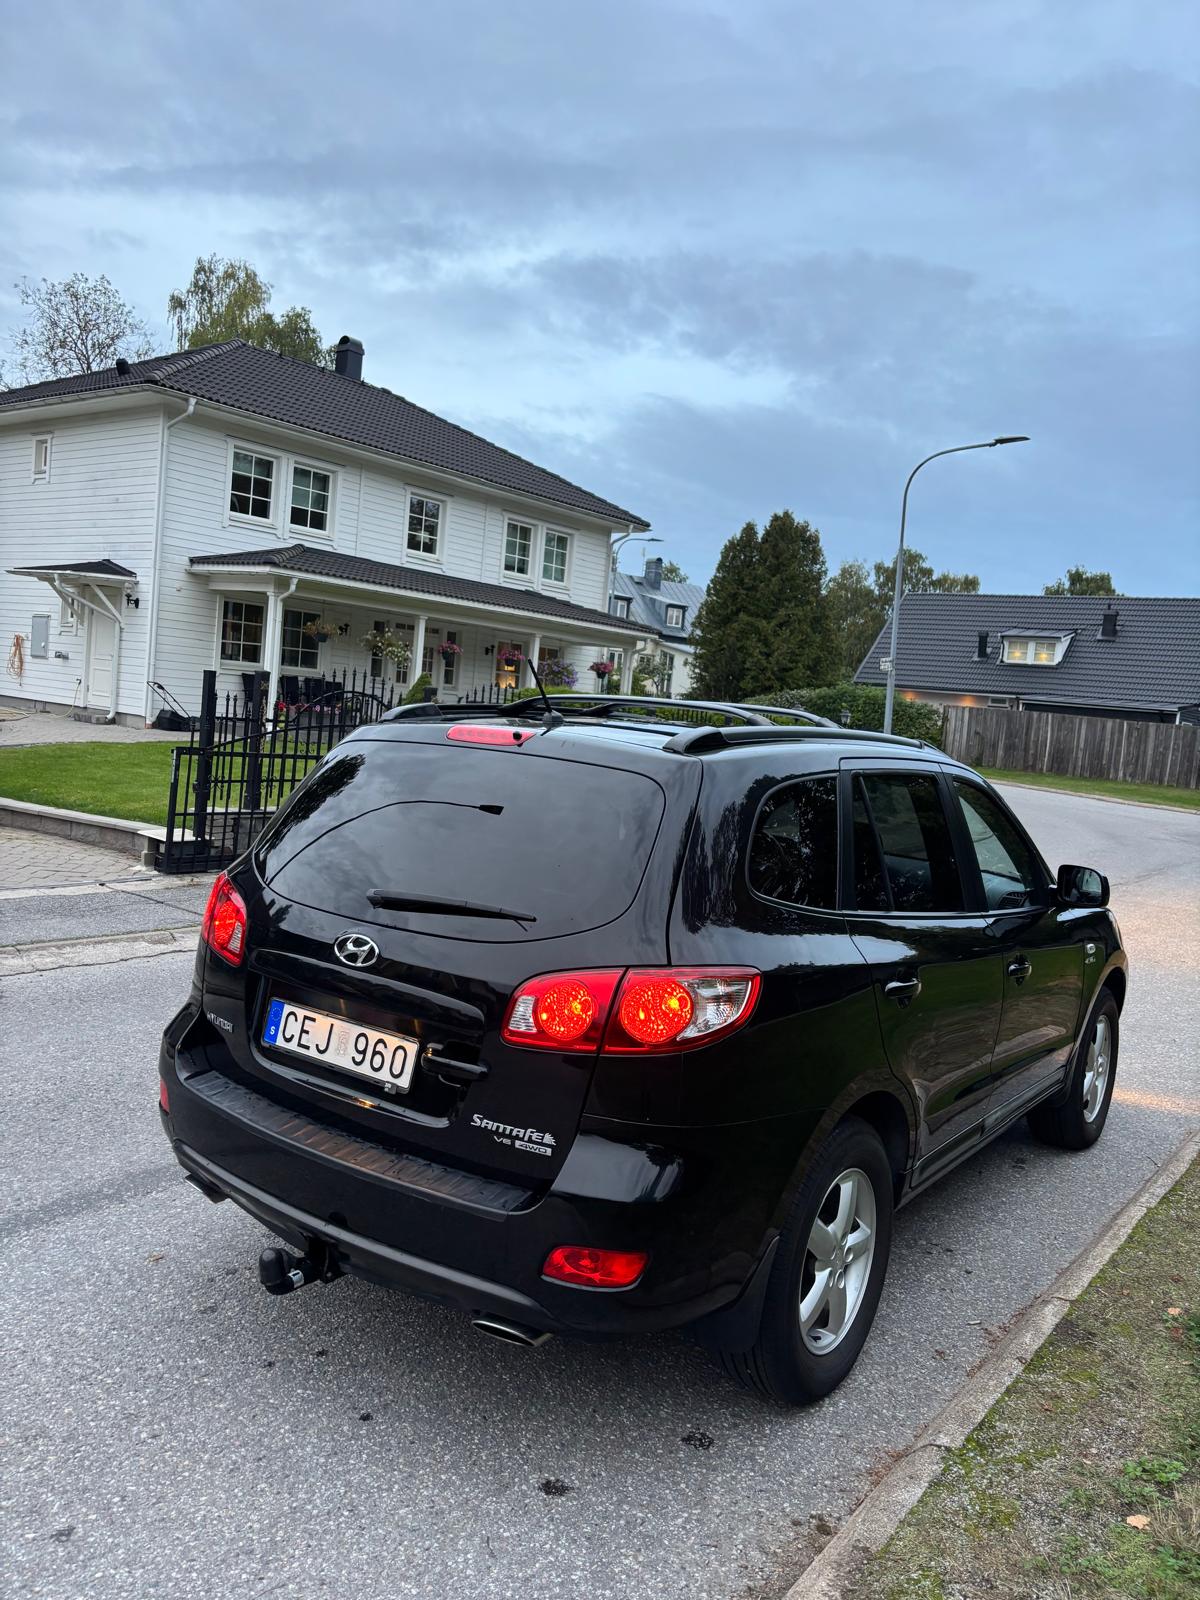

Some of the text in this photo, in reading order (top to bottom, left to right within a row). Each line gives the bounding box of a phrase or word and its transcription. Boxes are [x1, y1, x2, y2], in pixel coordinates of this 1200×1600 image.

[269, 1026, 276, 1035] S
[282, 1011, 408, 1079] CEJ 960
[494, 1135, 549, 1155] V6 4WD
